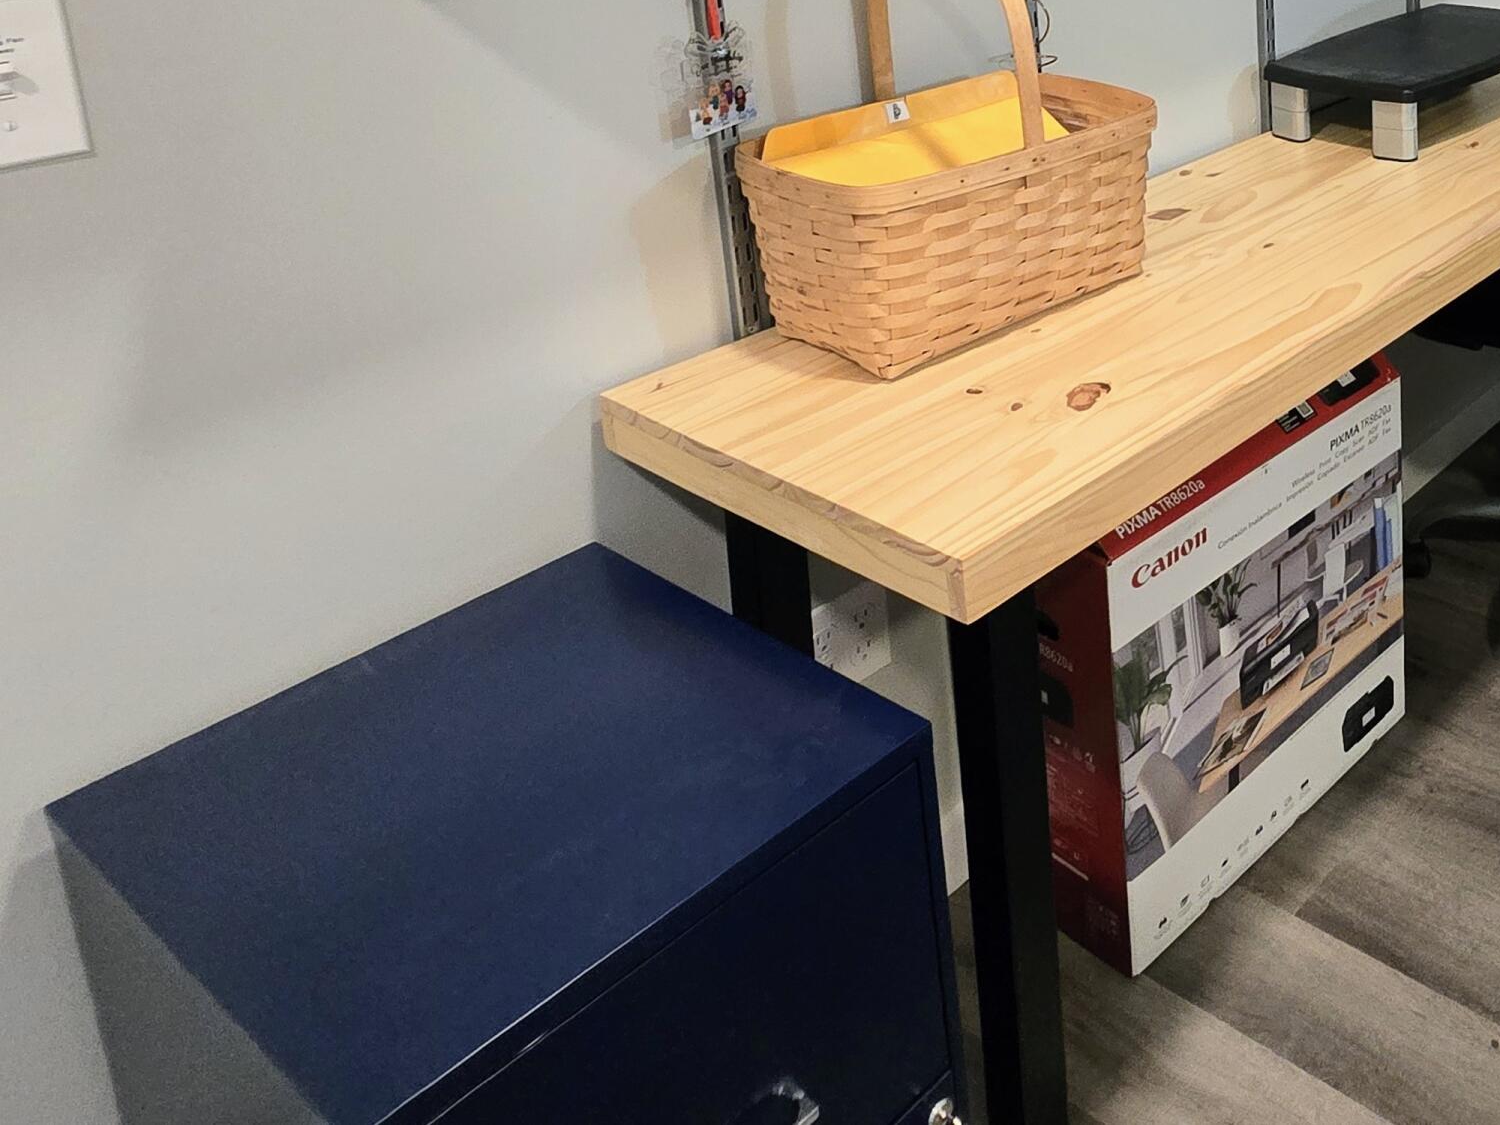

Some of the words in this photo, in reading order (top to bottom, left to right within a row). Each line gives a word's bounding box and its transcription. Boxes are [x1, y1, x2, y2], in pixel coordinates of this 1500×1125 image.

[1328, 424, 1360, 451] PIXMA
[1360, 404, 1392, 431] TR8620a
[1115, 505, 1161, 540] PIXMA
[1160, 477, 1206, 514] TR8620a
[1131, 527, 1208, 589] Canon
